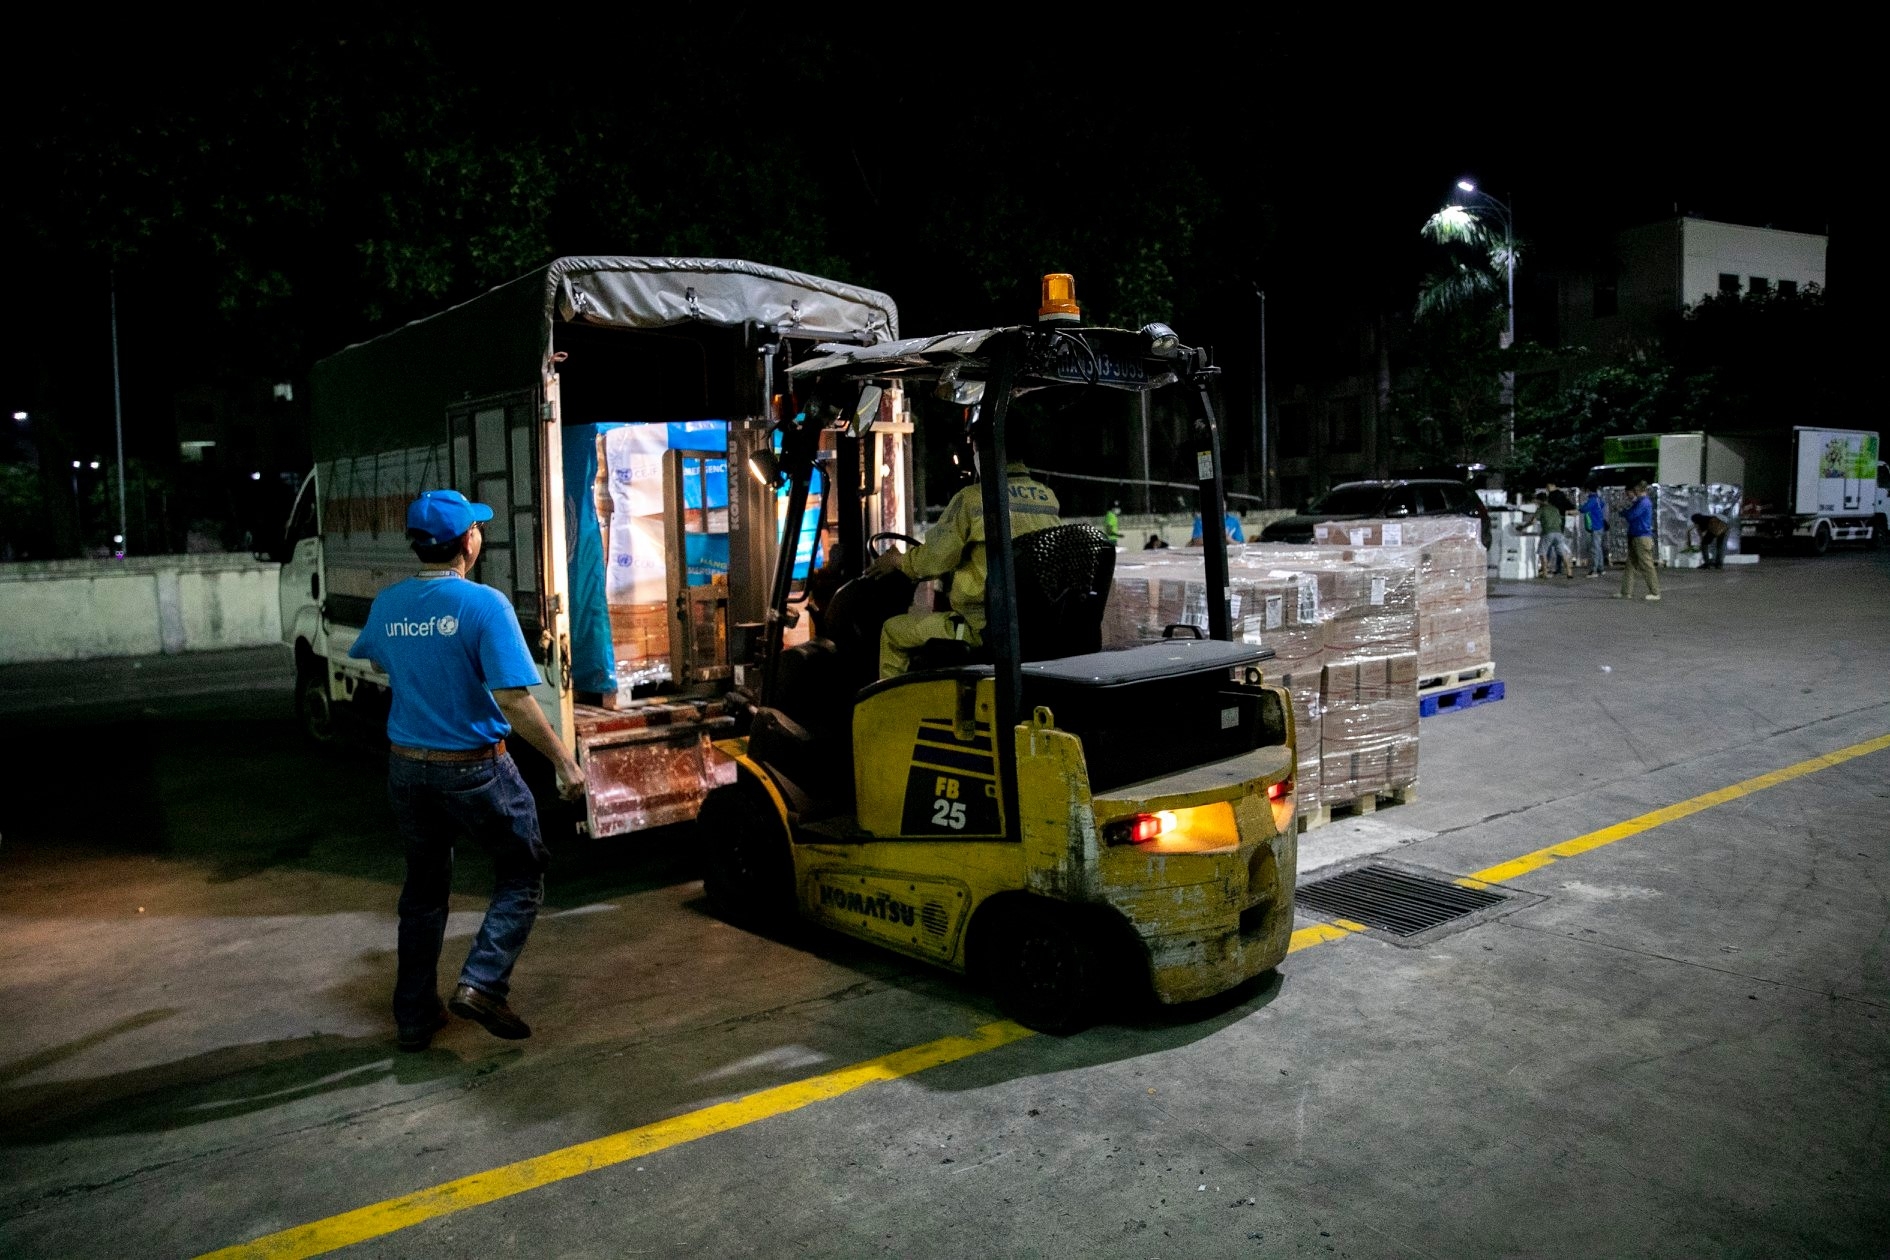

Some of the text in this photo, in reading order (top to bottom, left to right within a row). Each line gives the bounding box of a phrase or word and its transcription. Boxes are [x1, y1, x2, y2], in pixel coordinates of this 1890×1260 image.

[384, 616, 436, 637] unicef
[934, 775, 960, 800] FB
[931, 798, 967, 830] 25
[820, 885, 914, 927] KOMATSU
